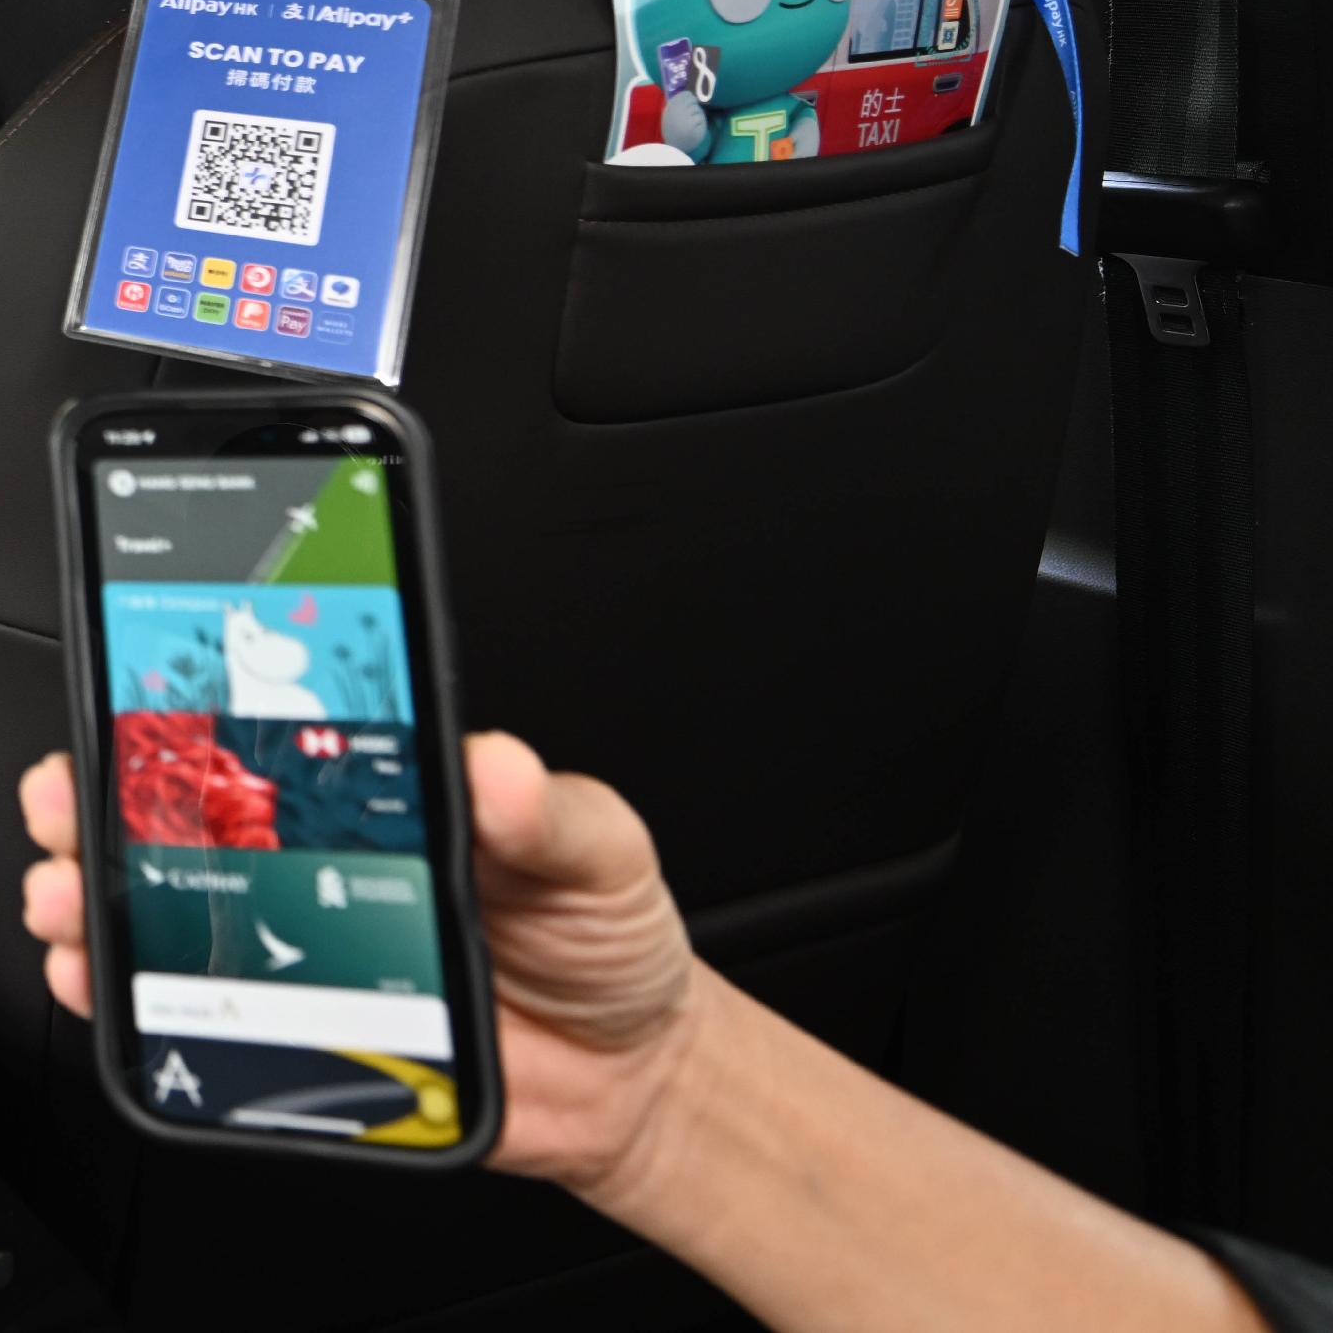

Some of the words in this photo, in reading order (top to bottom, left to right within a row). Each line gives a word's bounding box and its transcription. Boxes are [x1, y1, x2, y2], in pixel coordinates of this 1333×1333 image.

[317, 6, 413, 31] Alipay+
[188, 41, 262, 64] SCAN
[268, 48, 304, 68] TO
[309, 53, 365, 74] PAY
[226, 69, 317, 94] 掃碼付款
[860, 87, 905, 118] 的士
[857, 119, 900, 148] TAXI
